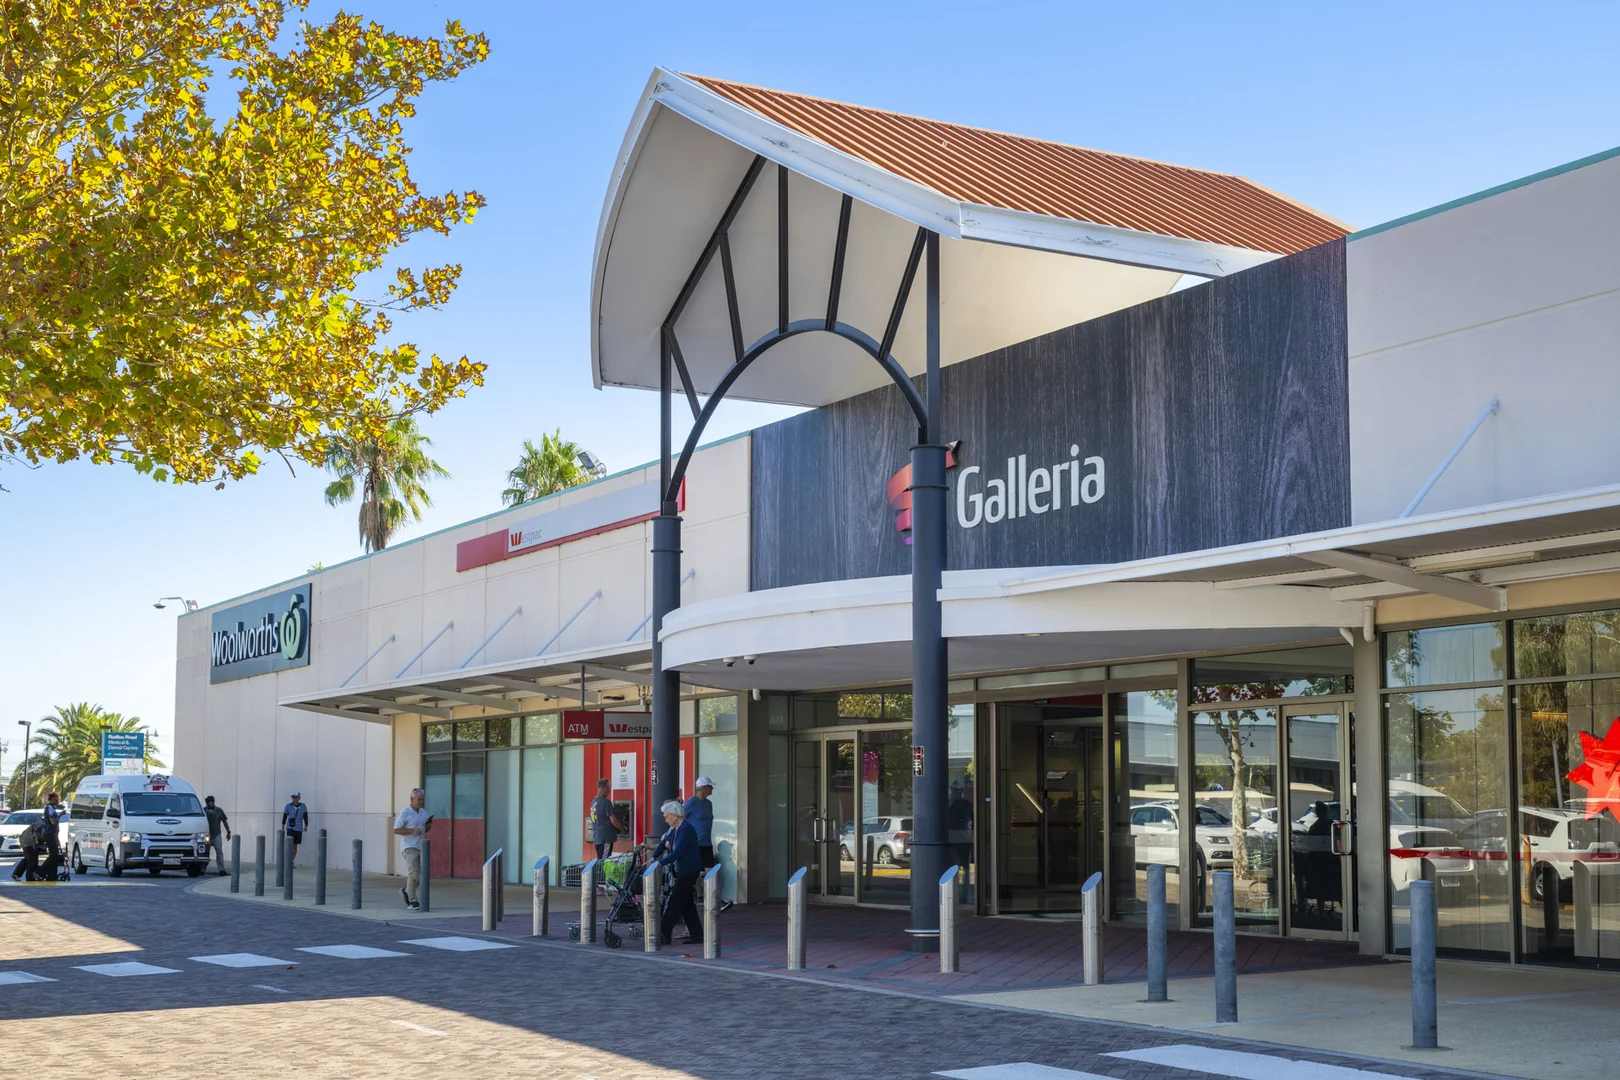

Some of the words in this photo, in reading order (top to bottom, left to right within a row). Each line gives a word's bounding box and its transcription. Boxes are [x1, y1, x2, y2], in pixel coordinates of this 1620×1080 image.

[957, 444, 1106, 529] Galleria
[510, 529, 542, 547] Westpac
[211, 613, 279, 667] Woolworths
[568, 723, 589, 734] ATM
[608, 723, 652, 735] Westpa
